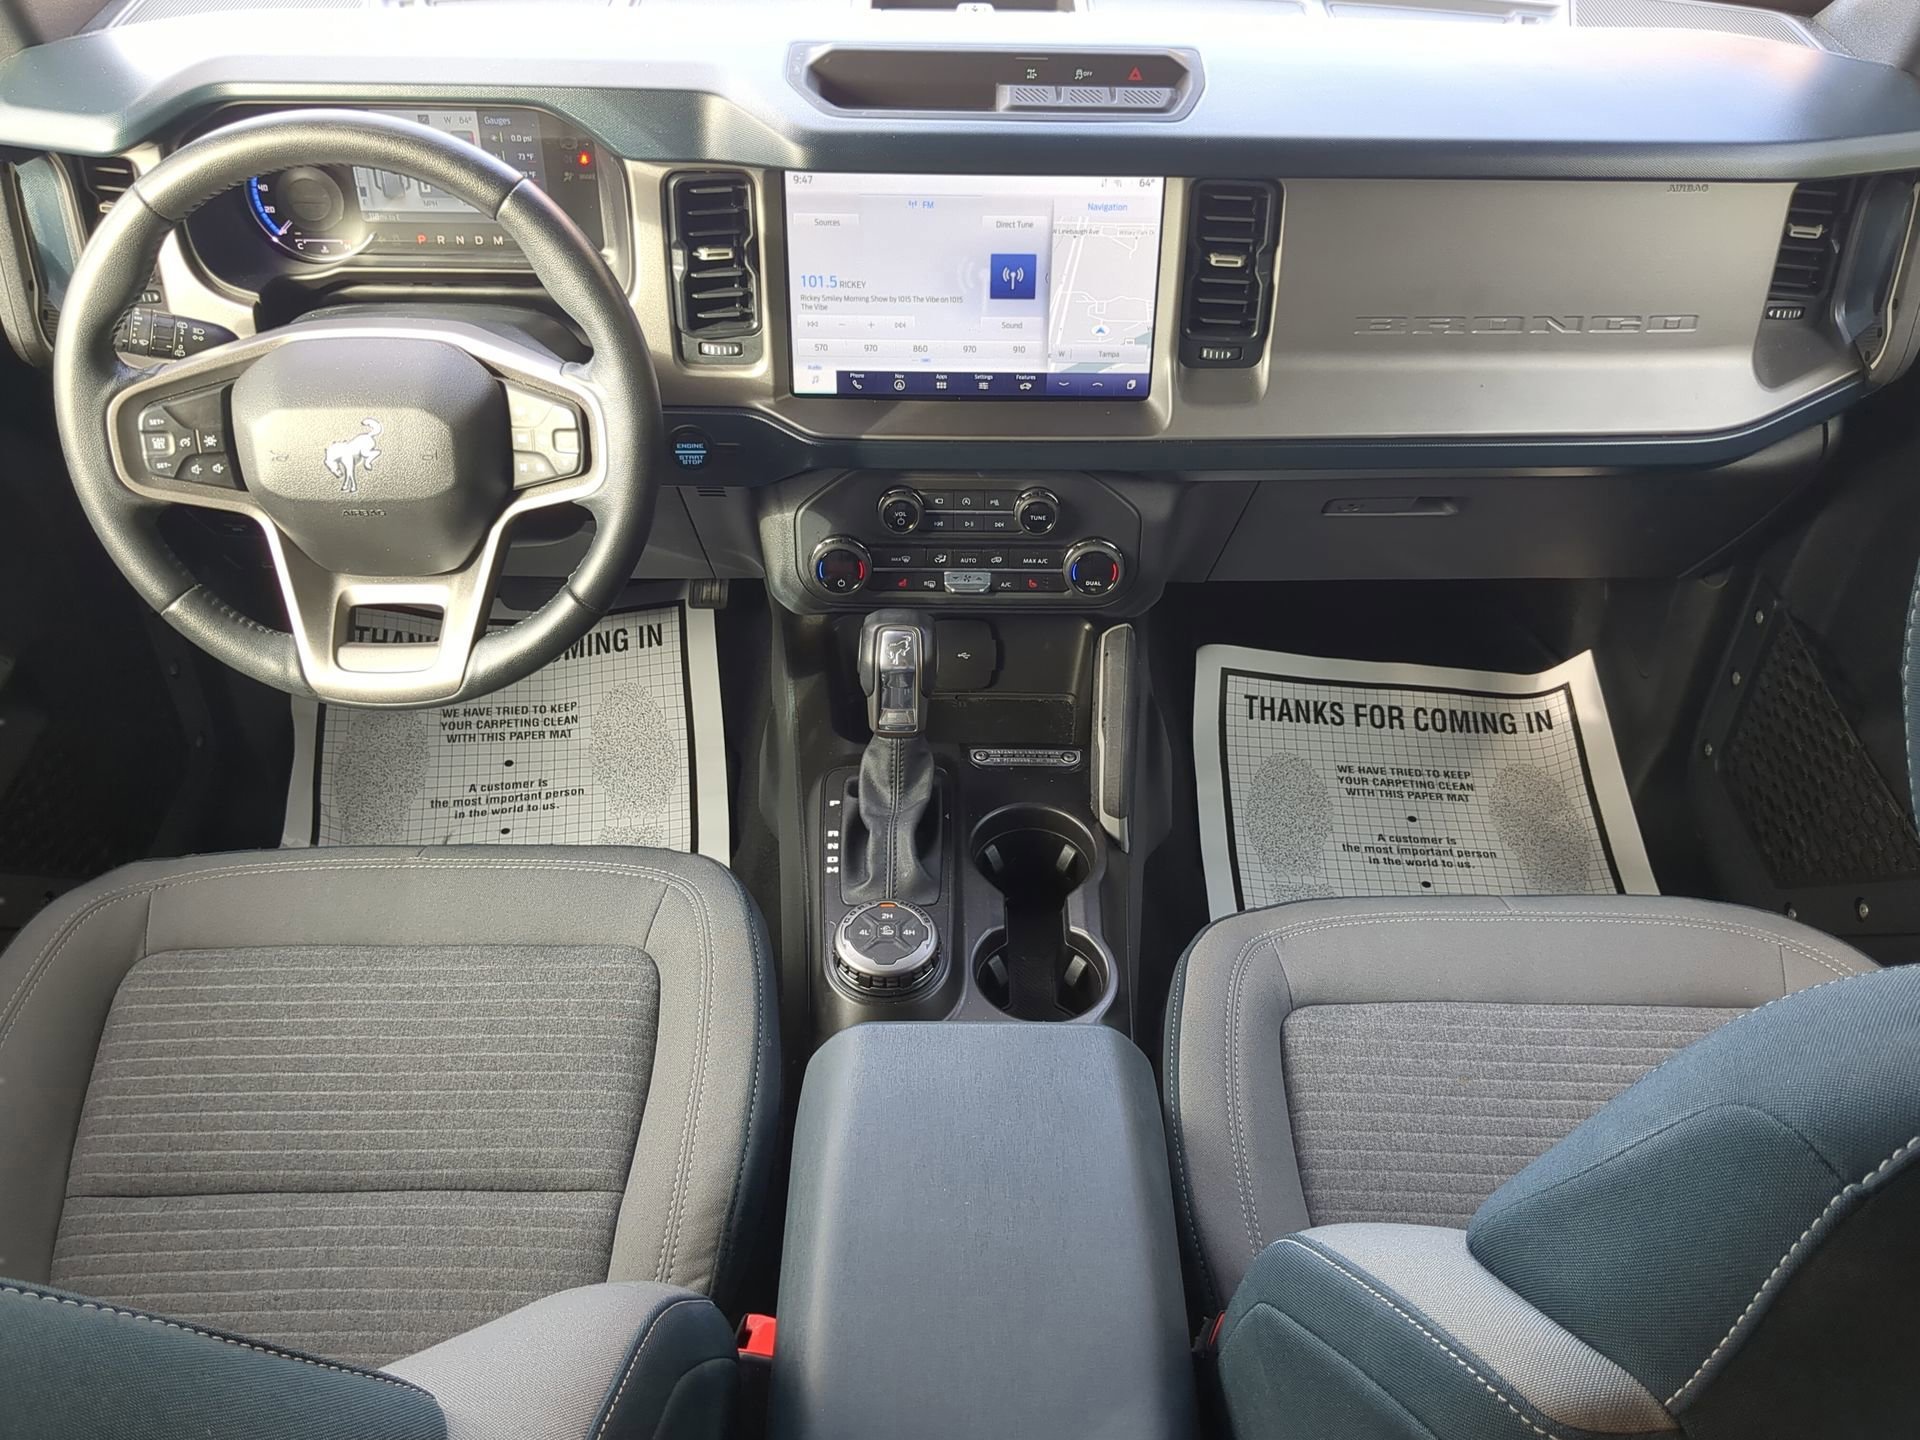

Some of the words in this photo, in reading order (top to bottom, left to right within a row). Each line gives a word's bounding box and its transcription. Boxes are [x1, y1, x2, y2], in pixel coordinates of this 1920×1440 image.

[484, 116, 511, 125] Gauges
[793, 175, 813, 185] 9:47
[1139, 178, 1156, 188] 64°
[257, 184, 269, 192] 40
[1667, 183, 1709, 192] AIRBAG
[264, 206, 276, 214] 20
[922, 201, 935, 209] FM
[1087, 202, 1128, 212] Navigation
[814, 218, 841, 227] Sources
[996, 221, 1016, 229] Direct
[1017, 221, 1034, 229] Tune
[417, 234, 427, 245] P
[436, 235, 446, 245] R
[456, 235, 465, 245] N
[475, 235, 484, 245] D
[493, 235, 504, 245] M
[800, 275, 838, 288] 101.5
[839, 281, 866, 289] RICKEY
[800, 295, 821, 303] Rickey
[822, 295, 842, 303] Smiley
[843, 296, 870, 304] Morning
[889, 296, 897, 304] by
[949, 296, 963, 304] 1015
[1001, 322, 1023, 330] Sound
[1354, 315, 1699, 335] BRONCO
[814, 344, 828, 352] 570
[864, 344, 878, 352] 970
[913, 345, 928, 353] 860
[1098, 351, 1120, 359] Tampa
[639, 623, 663, 649] IN
[442, 708, 459, 718] WE
[463, 707, 492, 717] HAVE
[496, 705, 529, 716] TRIED
[532, 704, 547, 714] TO
[551, 702, 577, 713] KEEP
[1244, 694, 1345, 726] THANKS
[1354, 703, 1405, 731] FOR
[1414, 707, 1518, 735] COMING
[1525, 709, 1554, 734] IN
[441, 720, 472, 730] YOUR
[476, 717, 540, 729] CARPETING
[543, 715, 578, 727] CLEAN
[447, 733, 476, 743] WITH
[480, 731, 505, 742] THIS
[510, 730, 546, 741] PAPER
[550, 729, 573, 739] MAT
[1337, 765, 1354, 774] WE
[1358, 766, 1387, 776] HAVE
[1390, 767, 1422, 777] TRIED
[1425, 769, 1440, 778] TO
[1443, 770, 1471, 780] KEEP
[469, 784, 477, 793] A
[480, 779, 535, 792] customer
[539, 778, 548, 787] is
[1337, 776, 1369, 786] YOUR
[1372, 777, 1435, 790] CARPETING
[1438, 781, 1474, 792] CLEAN
[431, 800, 448, 809] the
[453, 796, 482, 808] most
[486, 792, 542, 805] important
[545, 788, 585, 800] person
[1345, 788, 1375, 797] WITH
[1379, 789, 1404, 799] THIS
[1408, 791, 1444, 801] PAPER
[1447, 793, 1470, 802] MAT
[454, 810, 465, 819] in
[469, 808, 487, 818] the
[491, 805, 524, 816] world
[528, 803, 539, 812] to
[543, 802, 560, 811] us.
[1377, 834, 1386, 842] A
[1389, 835, 1443, 845] customer
[1446, 836, 1457, 845] is
[1342, 843, 1360, 853] the
[1364, 845, 1393, 854] most
[1397, 845, 1453, 857] important
[1457, 850, 1497, 860] person
[1368, 856, 1381, 865] in
[1383, 857, 1402, 866] the
[1405, 858, 1439, 867] world
[1441, 860, 1453, 868] to
